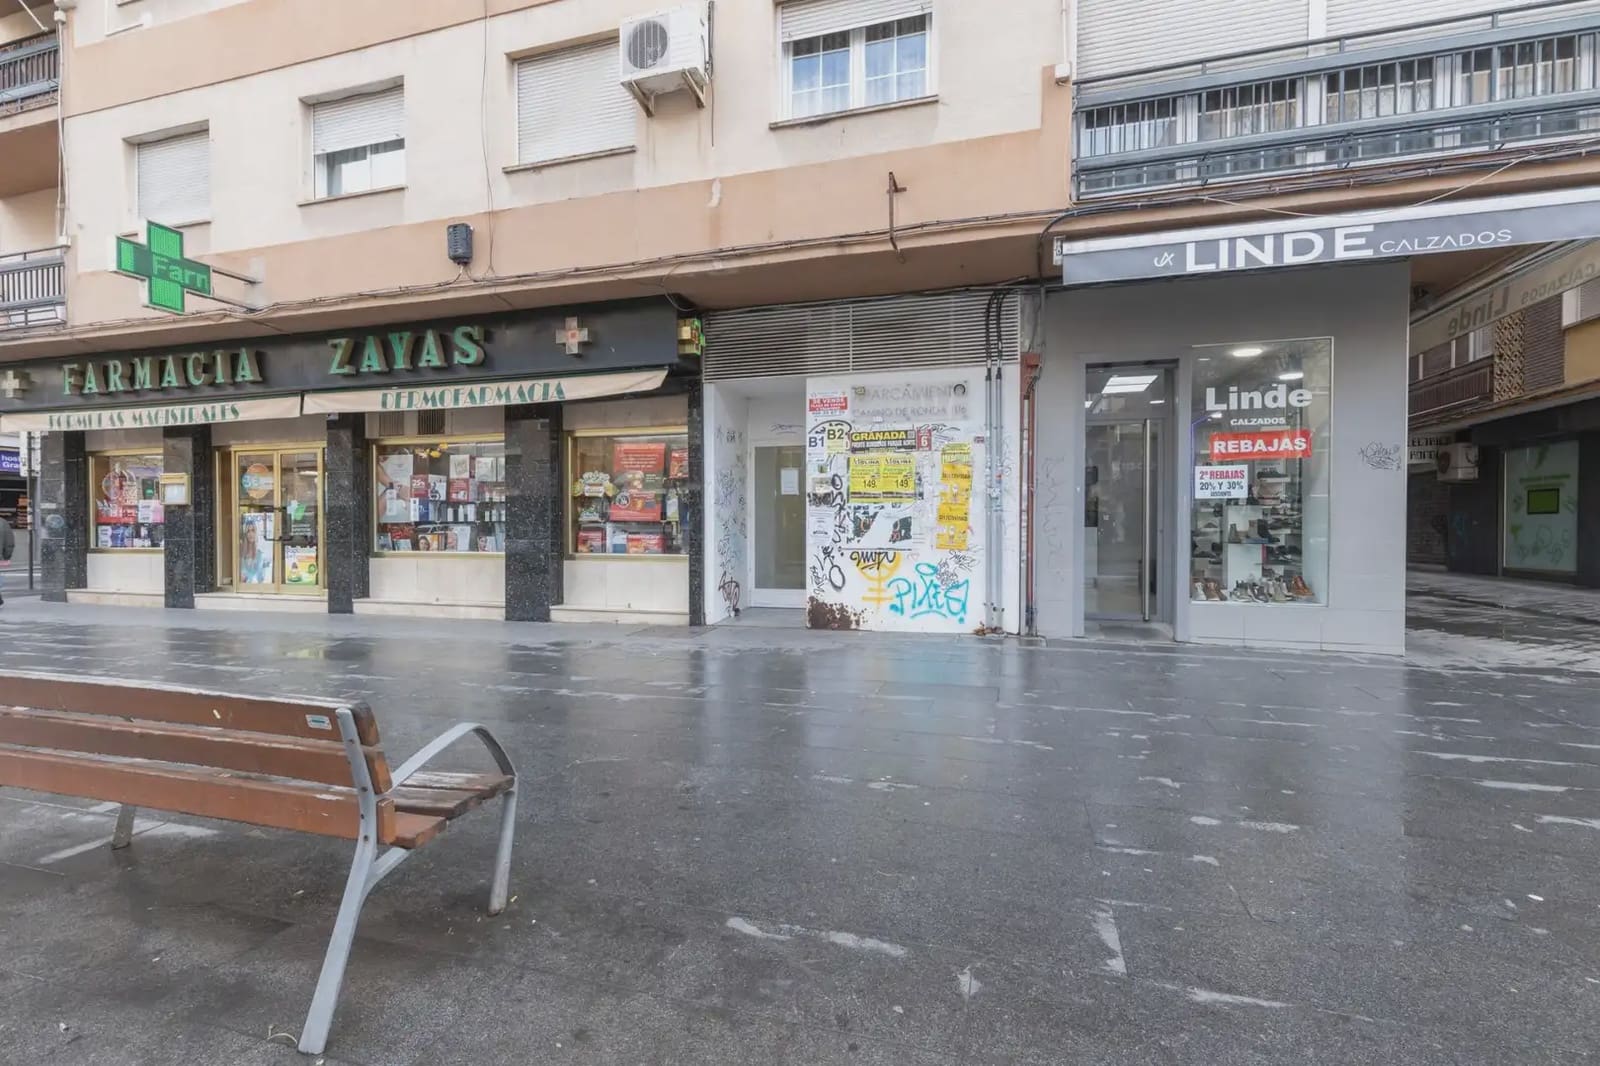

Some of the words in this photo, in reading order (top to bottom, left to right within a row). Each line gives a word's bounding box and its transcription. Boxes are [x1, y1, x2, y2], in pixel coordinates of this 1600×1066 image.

[1185, 223, 1376, 272] LINDE
[1379, 229, 1513, 253] CALZADOS
[62, 347, 257, 396] FARMACIA
[327, 325, 486, 377] ZAYAS
[380, 381, 567, 410] DERMOFARMACIA
[1205, 383, 1314, 411] Linde
[132, 404, 240, 427] MAGISTRALES
[895, 407, 908, 417] DE
[1230, 416, 1286, 426] CALZADOS
[827, 428, 844, 440] B2
[852, 431, 906, 442] GRANADA
[808, 437, 825, 448] B1
[921, 436, 928, 447] 6
[1213, 437, 1308, 454] REBAJAS
[1209, 469, 1245, 480] REBAJAS
[1200, 481, 1216, 491] 20%
[1217, 481, 1223, 490] Y
[1227, 480, 1244, 490] 30%
